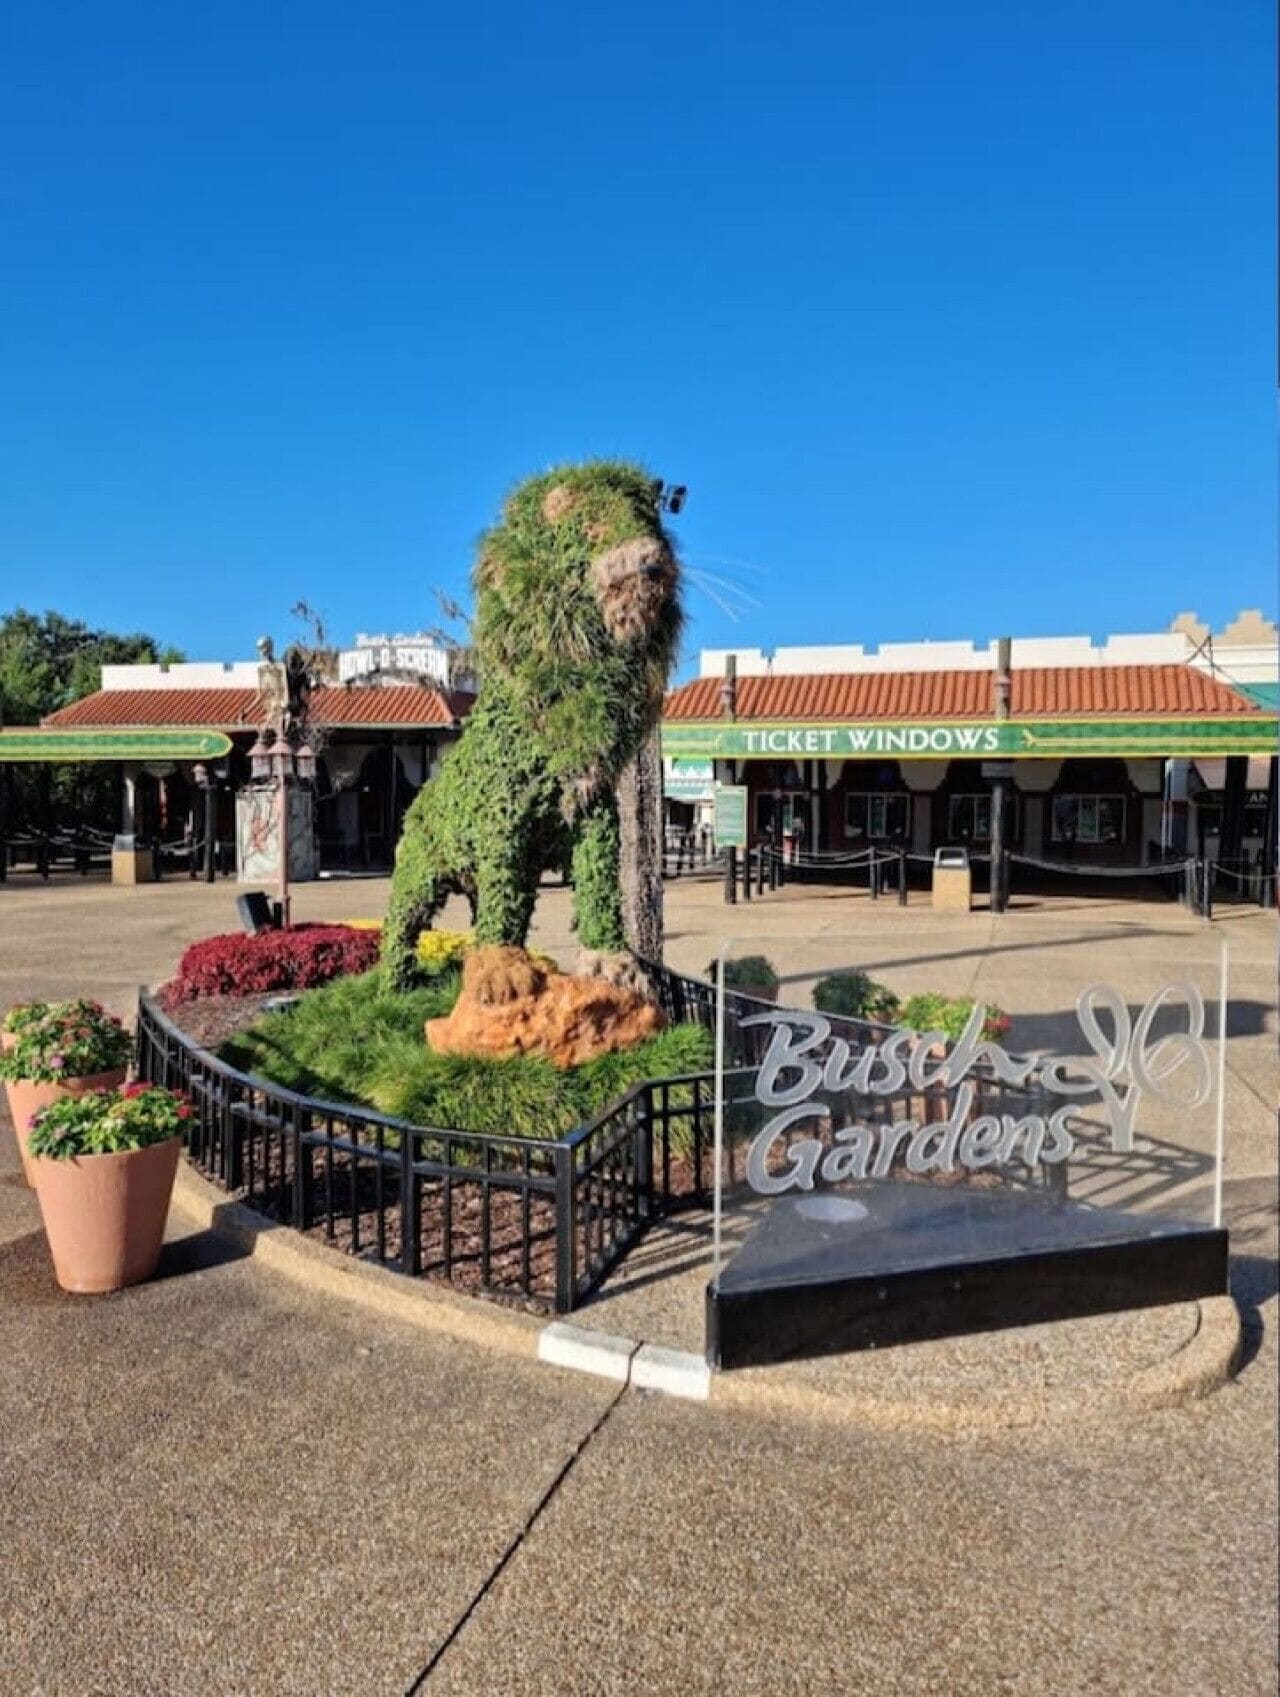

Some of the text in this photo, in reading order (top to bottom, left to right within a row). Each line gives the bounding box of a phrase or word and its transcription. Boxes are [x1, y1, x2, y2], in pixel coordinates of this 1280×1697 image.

[743, 728, 999, 751] TICKET WINDOWS
[739, 1002, 1036, 1106] Busch
[747, 1082, 1083, 1194] Gardens
